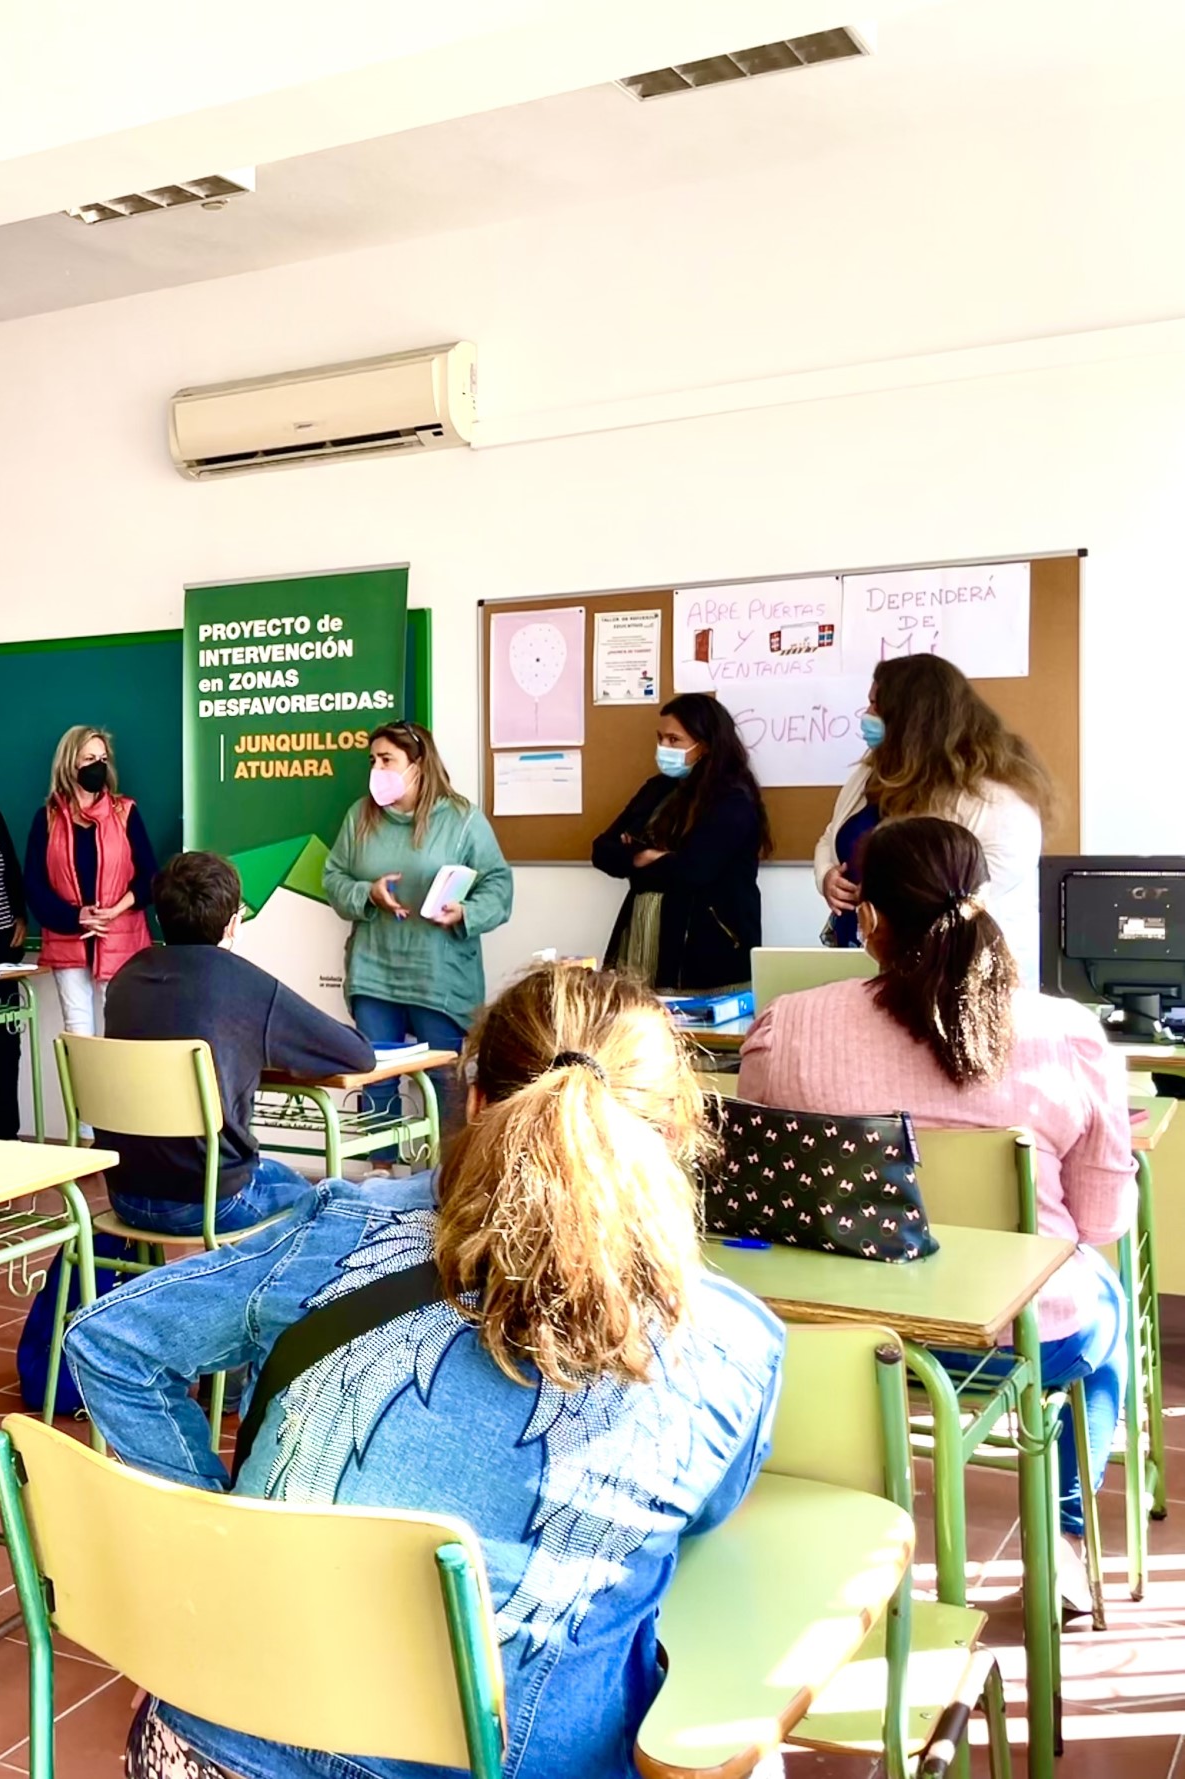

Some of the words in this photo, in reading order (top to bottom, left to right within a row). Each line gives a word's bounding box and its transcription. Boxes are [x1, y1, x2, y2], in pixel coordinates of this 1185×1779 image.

[866, 574, 996, 612] DEPENDERÁ
[687, 599, 740, 627] ABRE
[748, 598, 826, 620] PUERTAS
[897, 615, 935, 631] DE
[198, 616, 311, 642] PROYECTO
[317, 614, 343, 632] de
[198, 636, 354, 667] INTERVENCIÓN
[733, 630, 755, 652] Y
[198, 676, 223, 693] en
[228, 669, 299, 691] ZONAS
[707, 659, 815, 680] VENTANAS
[198, 690, 394, 718] DESFAVORECIDAS:
[234, 731, 370, 753] JUNQUILLOS
[234, 759, 334, 779] ATUNARA
